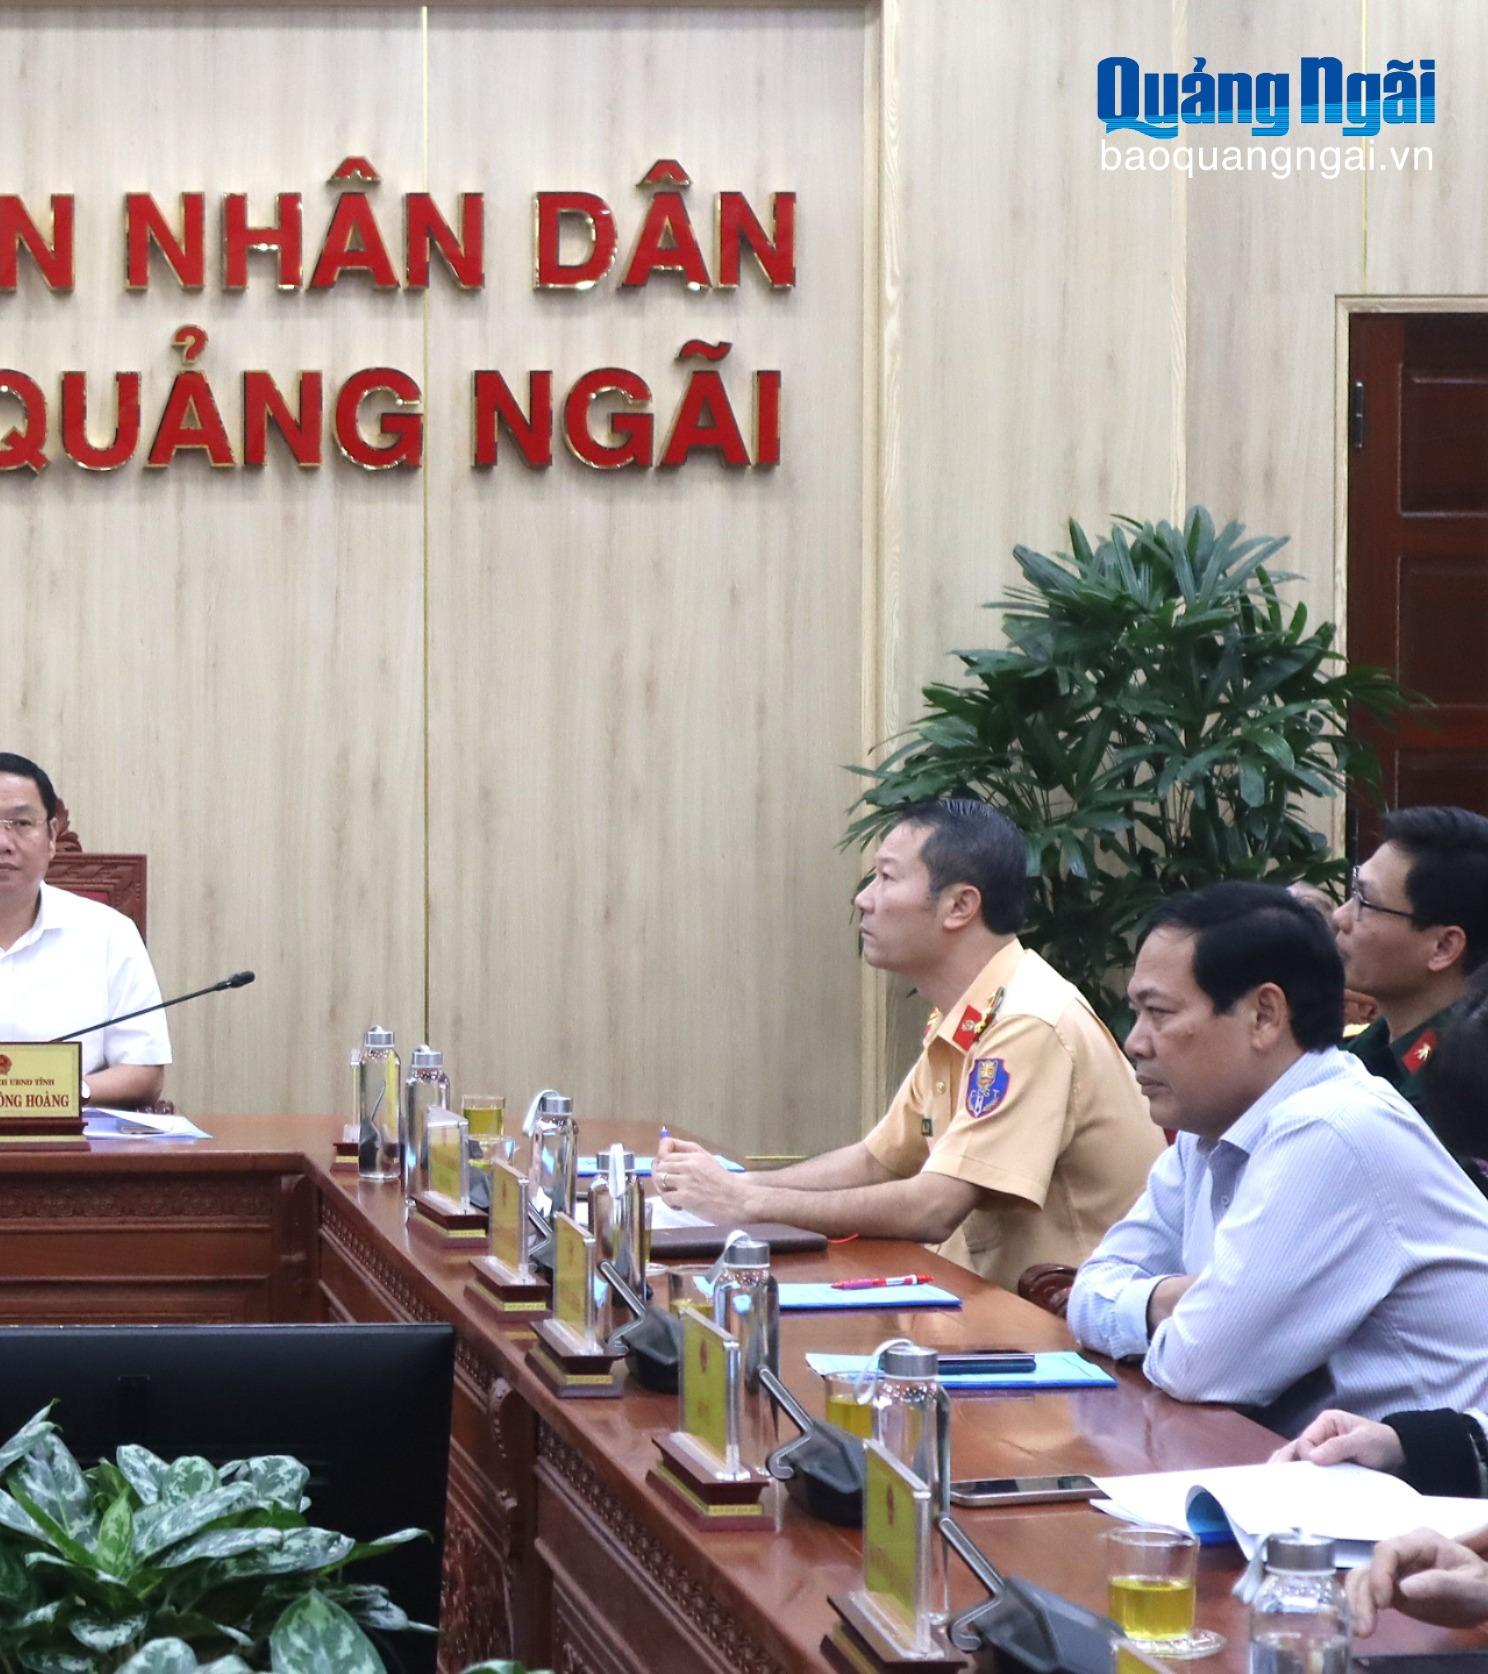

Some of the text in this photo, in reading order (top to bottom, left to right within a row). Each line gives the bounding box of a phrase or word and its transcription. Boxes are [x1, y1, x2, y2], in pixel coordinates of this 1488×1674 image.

[124, 156, 486, 291] NHÂN
[535, 158, 798, 290] DÂN
[474, 339, 782, 470] NGÃI
